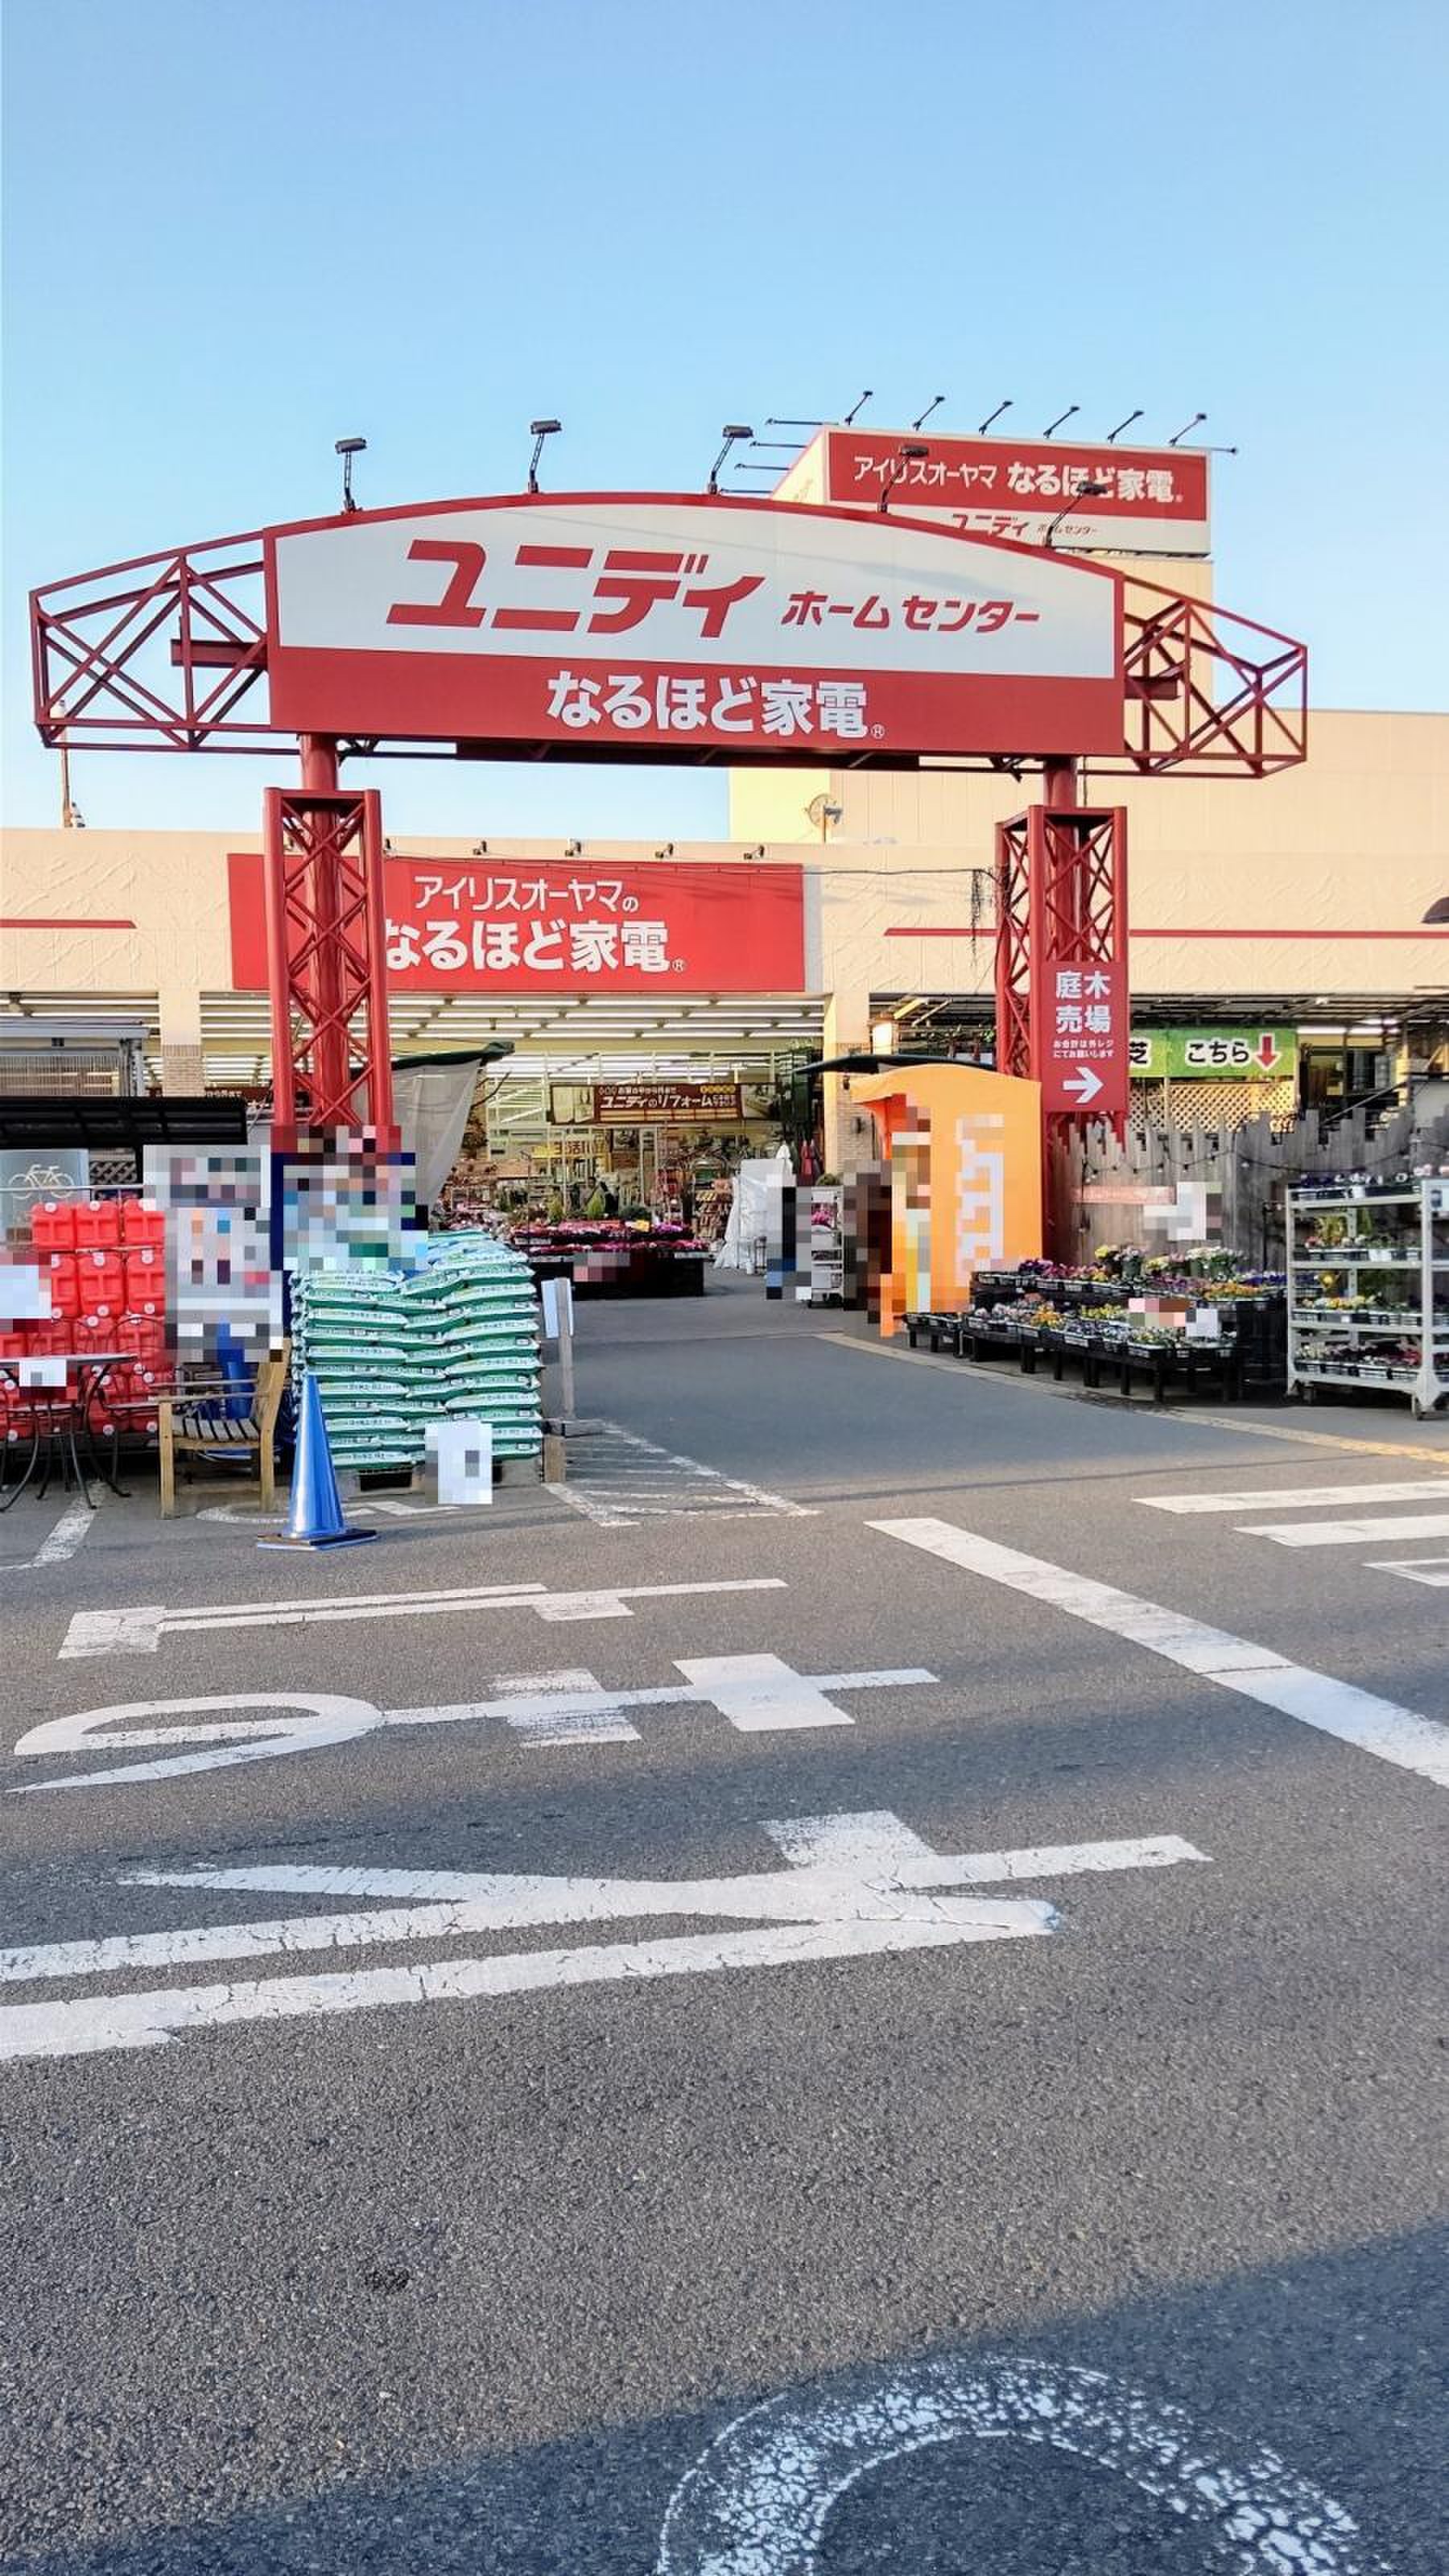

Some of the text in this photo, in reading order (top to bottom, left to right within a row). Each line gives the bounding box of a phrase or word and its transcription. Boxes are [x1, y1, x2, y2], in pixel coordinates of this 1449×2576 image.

[853, 456, 1174, 503] アイリスオーヤマ なるほど家電
[1037, 524, 1097, 535] ホムセンター
[386, 539, 765, 638] ユニディ
[547, 669, 869, 738] なるほど家電
[415, 876, 639, 912] アイリスオーヤマの
[386, 919, 671, 972] なるほど家電
[1055, 970, 1111, 999] 庭木
[1055, 1004, 1112, 1034] 売場
[1187, 1042, 1249, 1064] こちら
